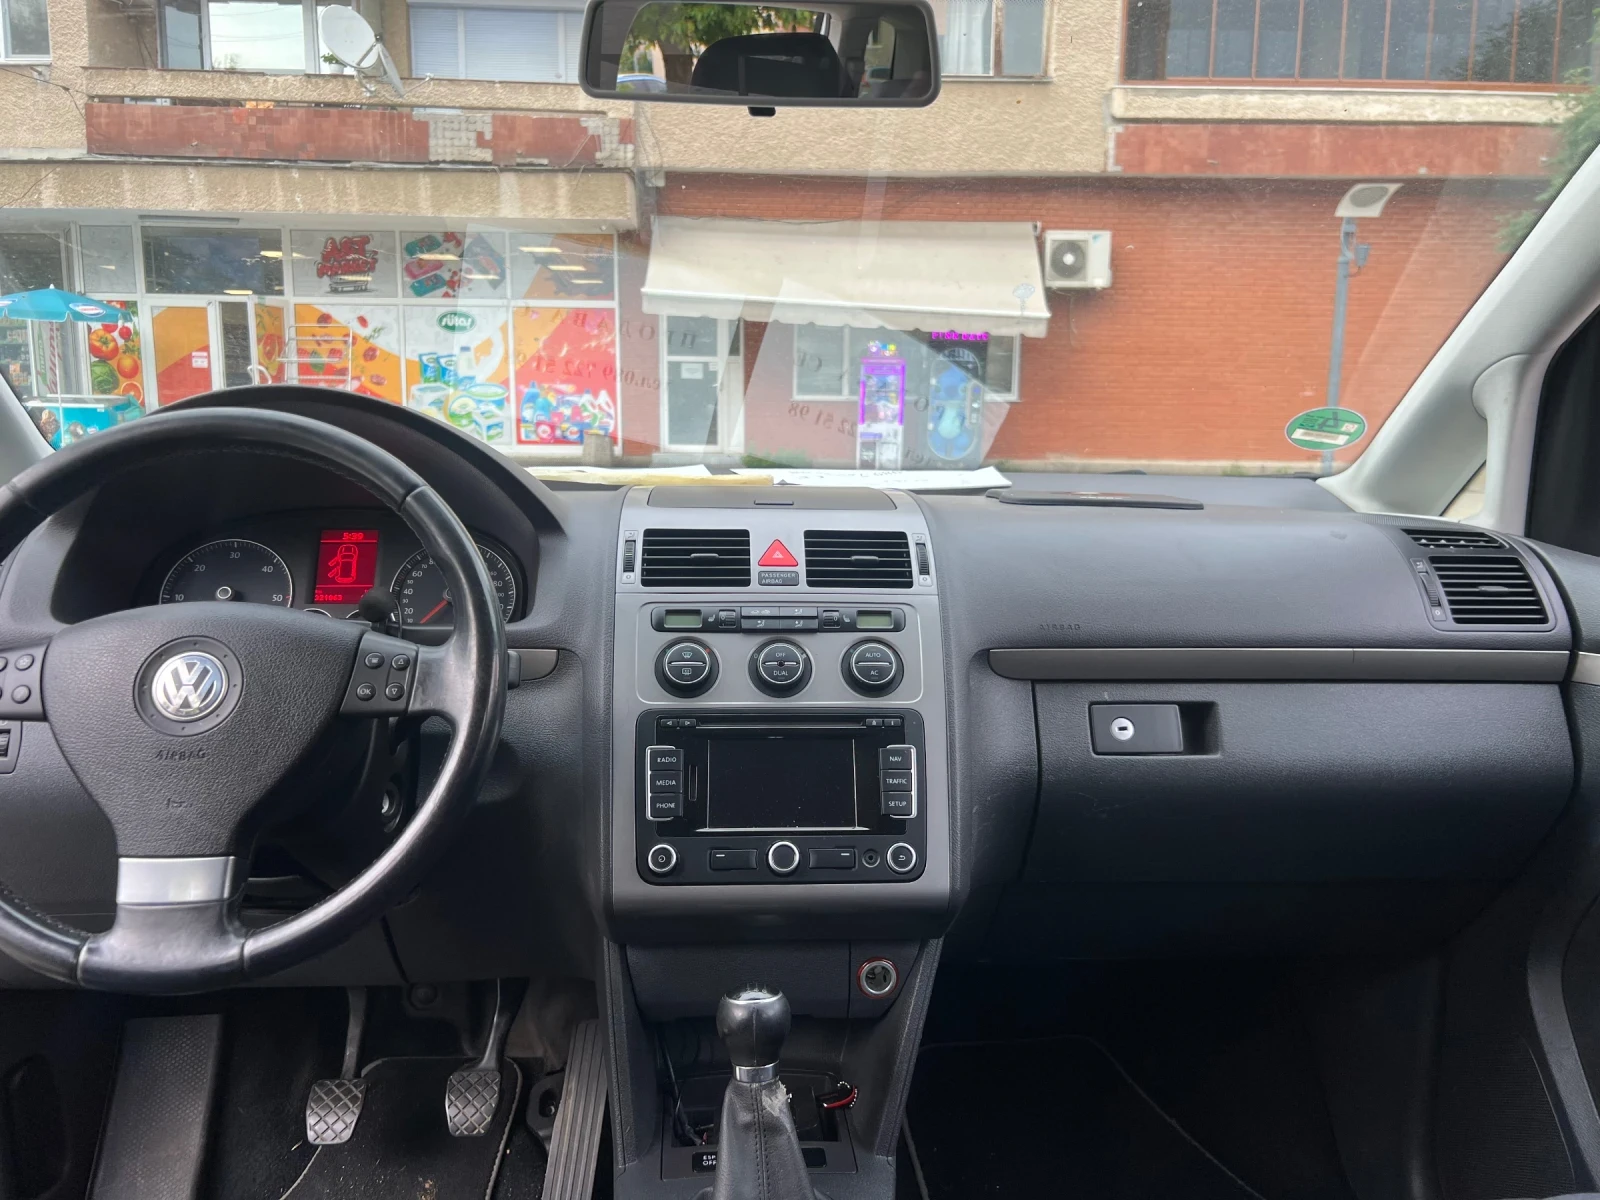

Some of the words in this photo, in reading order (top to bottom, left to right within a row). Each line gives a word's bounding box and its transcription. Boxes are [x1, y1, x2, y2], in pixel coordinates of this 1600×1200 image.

[229, 551, 241, 559] 30
[194, 564, 206, 572] 20
[261, 565, 274, 573] 40
[174, 594, 185, 602] 10
[272, 594, 283, 602] 50
[404, 607, 414, 615] 20
